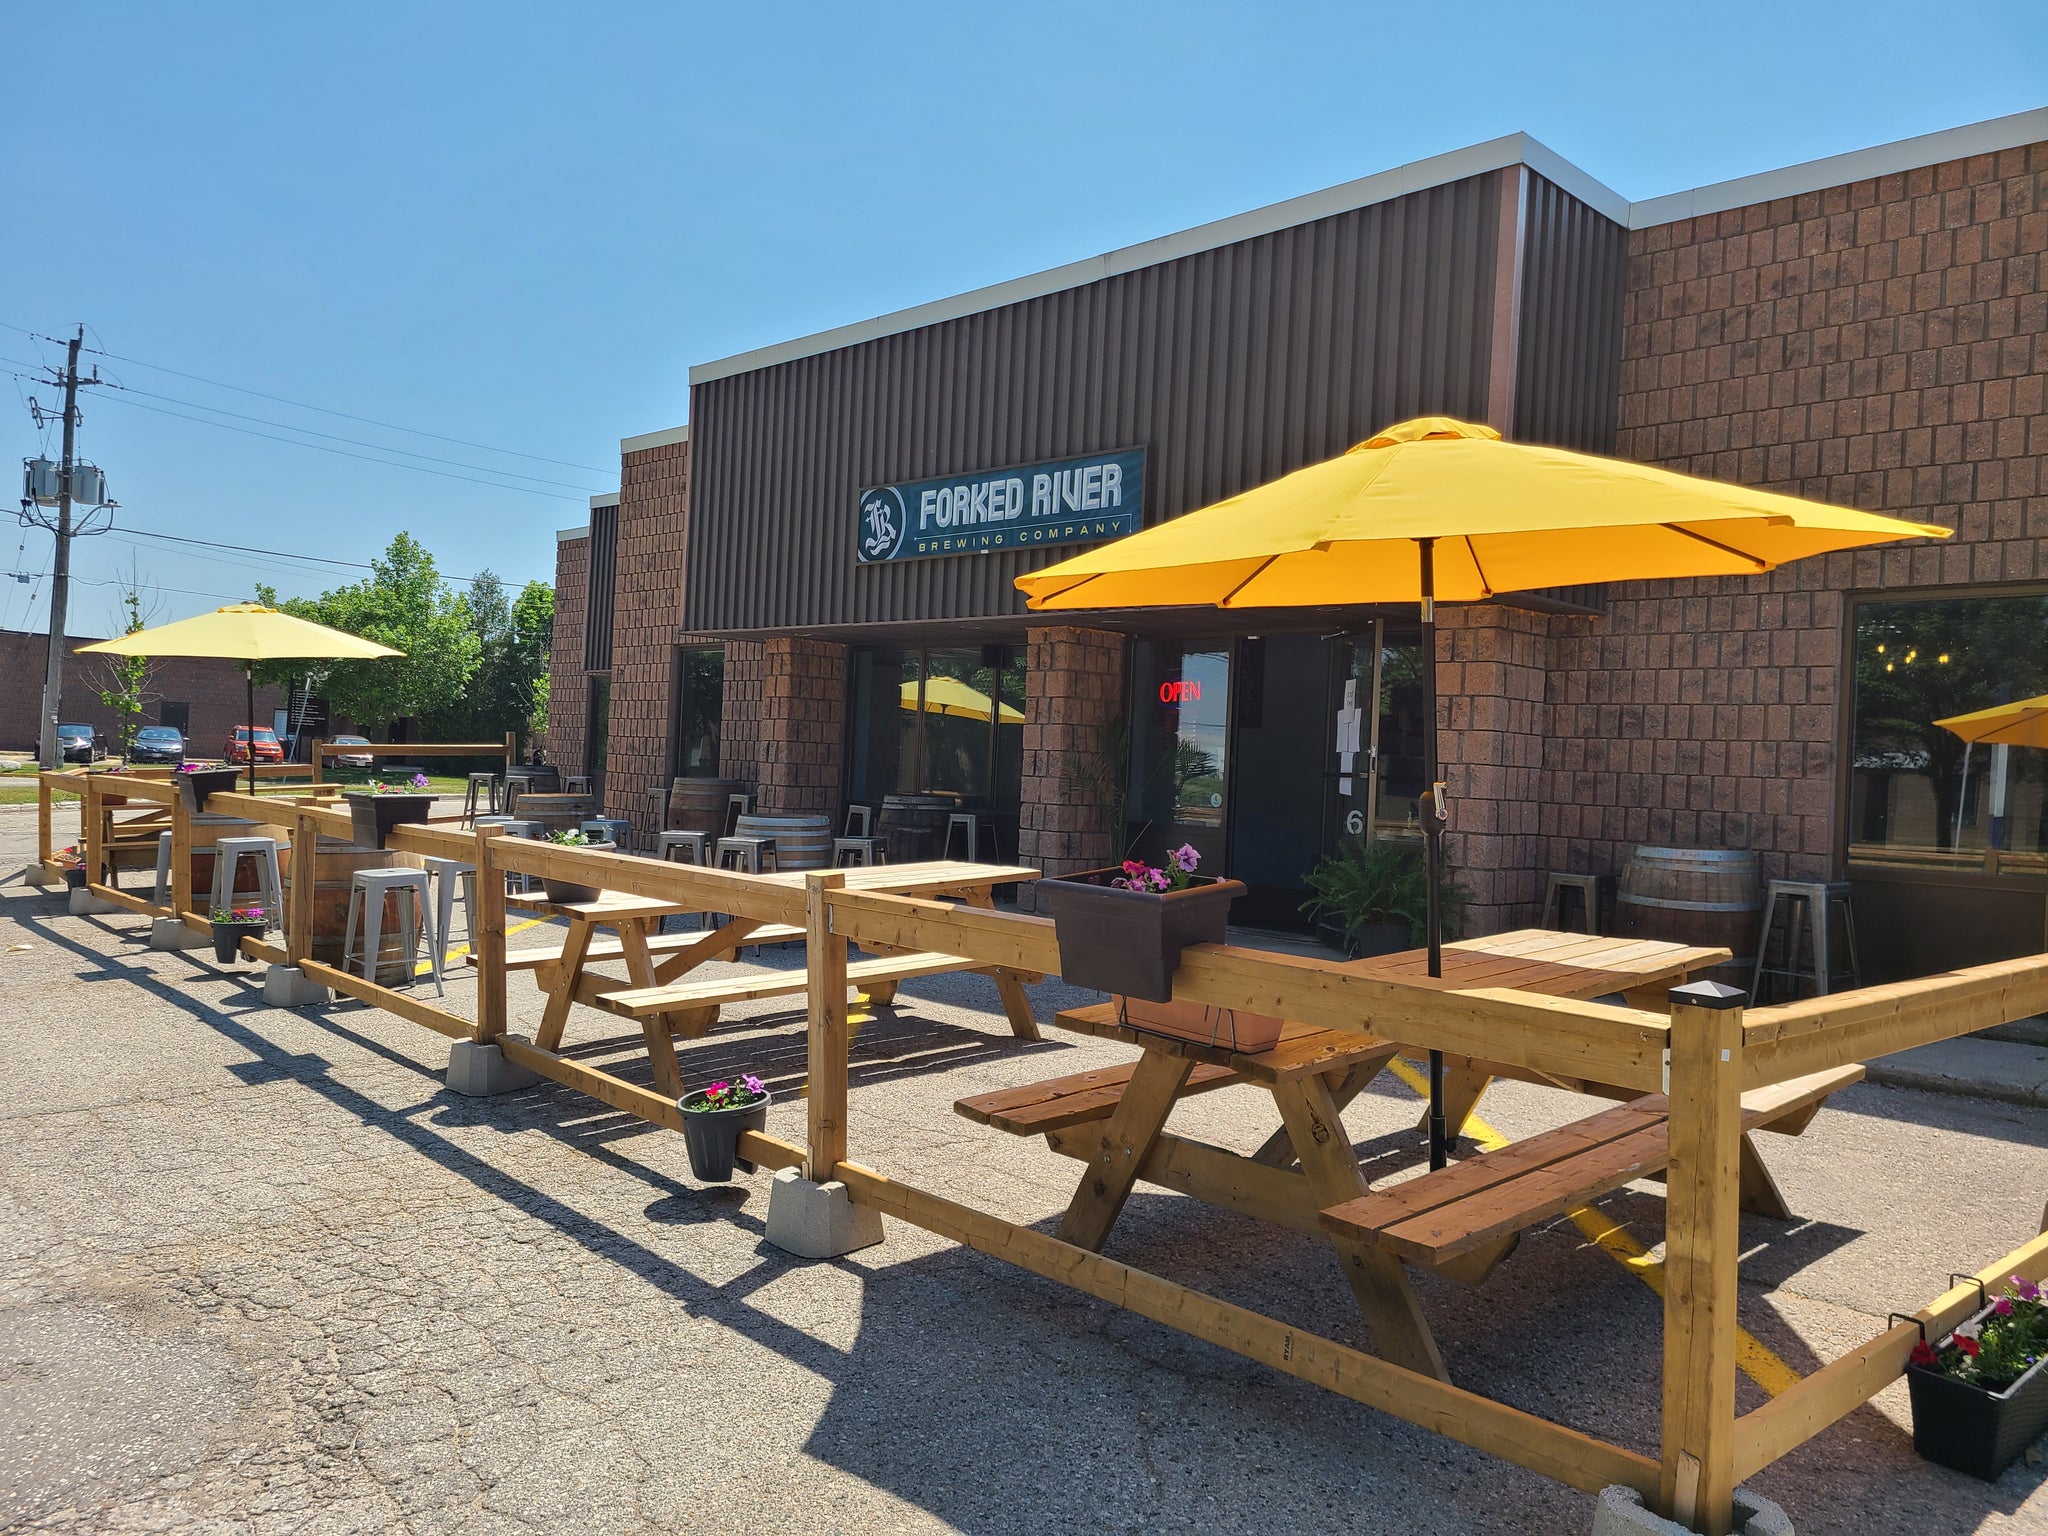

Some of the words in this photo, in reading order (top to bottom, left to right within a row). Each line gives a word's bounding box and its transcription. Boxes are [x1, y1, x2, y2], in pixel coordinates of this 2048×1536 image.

[919, 478, 1025, 530] FORKED
[1031, 463, 1123, 517] RIVER
[918, 534, 1004, 552] BREWING
[1019, 521, 1122, 542] COMPANY
[1160, 681, 1201, 703] OPEN
[1346, 810, 1364, 835] 6
